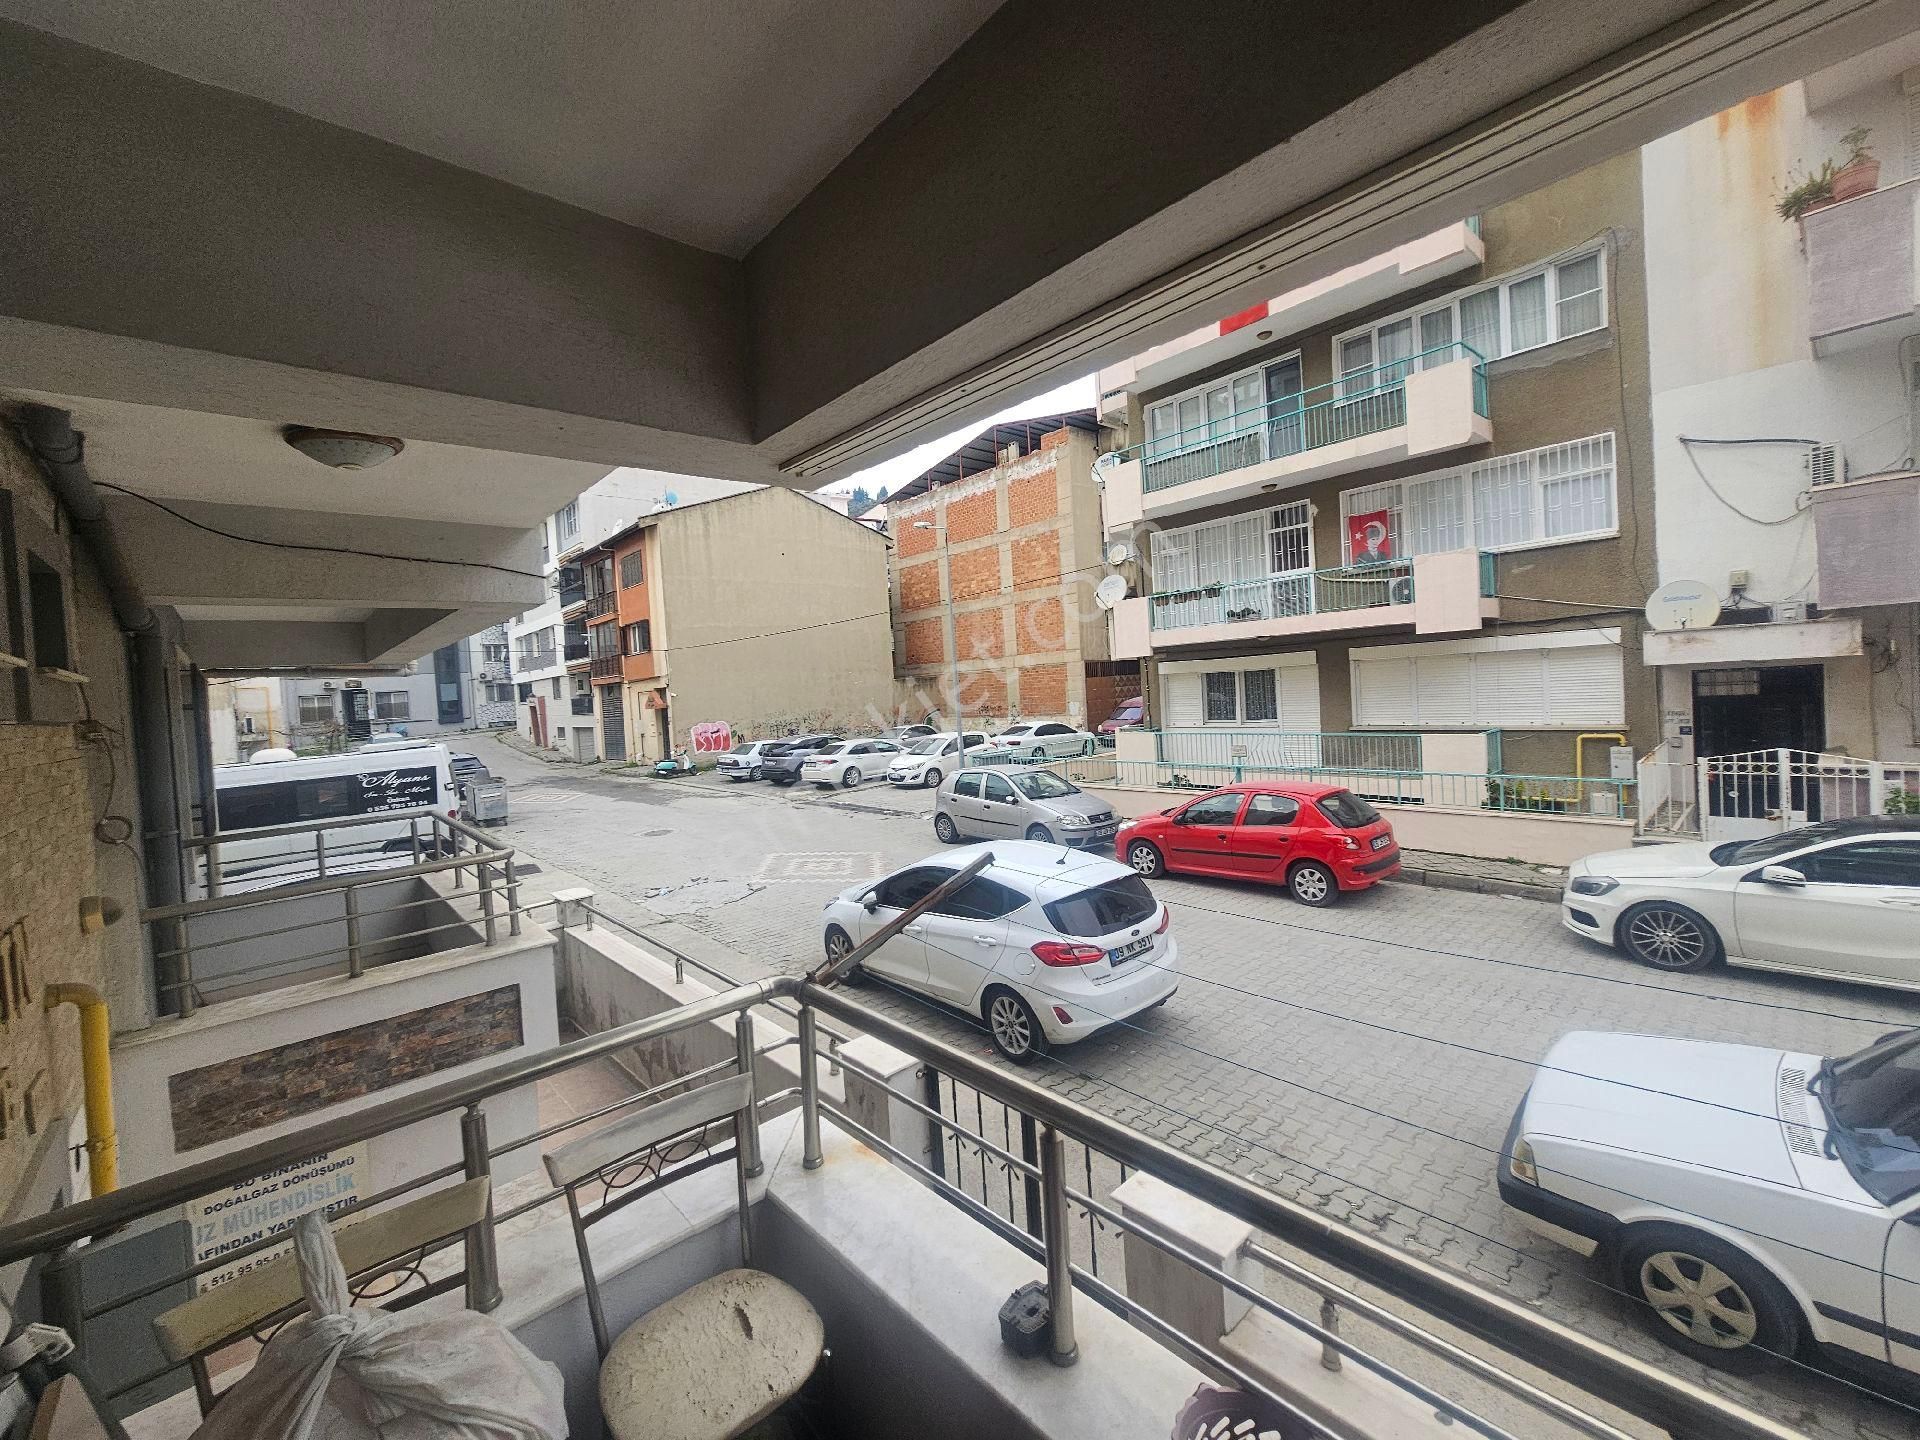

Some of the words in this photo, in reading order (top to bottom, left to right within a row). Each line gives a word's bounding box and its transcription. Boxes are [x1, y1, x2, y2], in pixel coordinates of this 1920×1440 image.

[204, 1183, 279, 1216] DOĞALGAZ
[282, 1155, 356, 1189] DÖNÜŞÜMÜ
[223, 1171, 357, 1236] MÜHENDİSLİK
